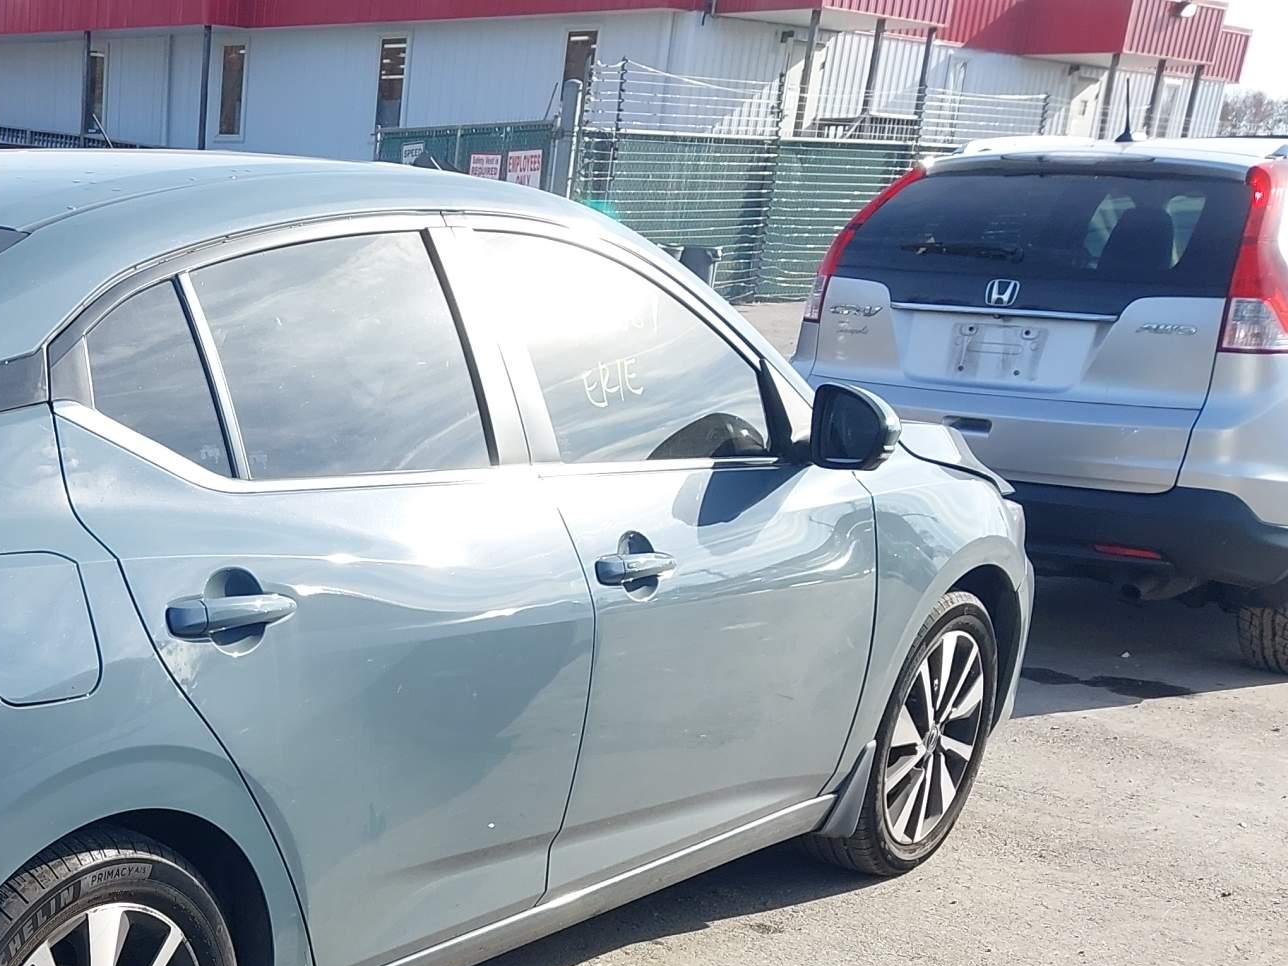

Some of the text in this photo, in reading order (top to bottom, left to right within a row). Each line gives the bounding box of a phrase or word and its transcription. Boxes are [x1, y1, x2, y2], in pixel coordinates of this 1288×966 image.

[471, 166, 498, 176] REQUIRED
[508, 154, 541, 173] EMPLOYEES
[582, 358, 644, 408] ERIE
[90, 865, 135, 886] PRIMACY
